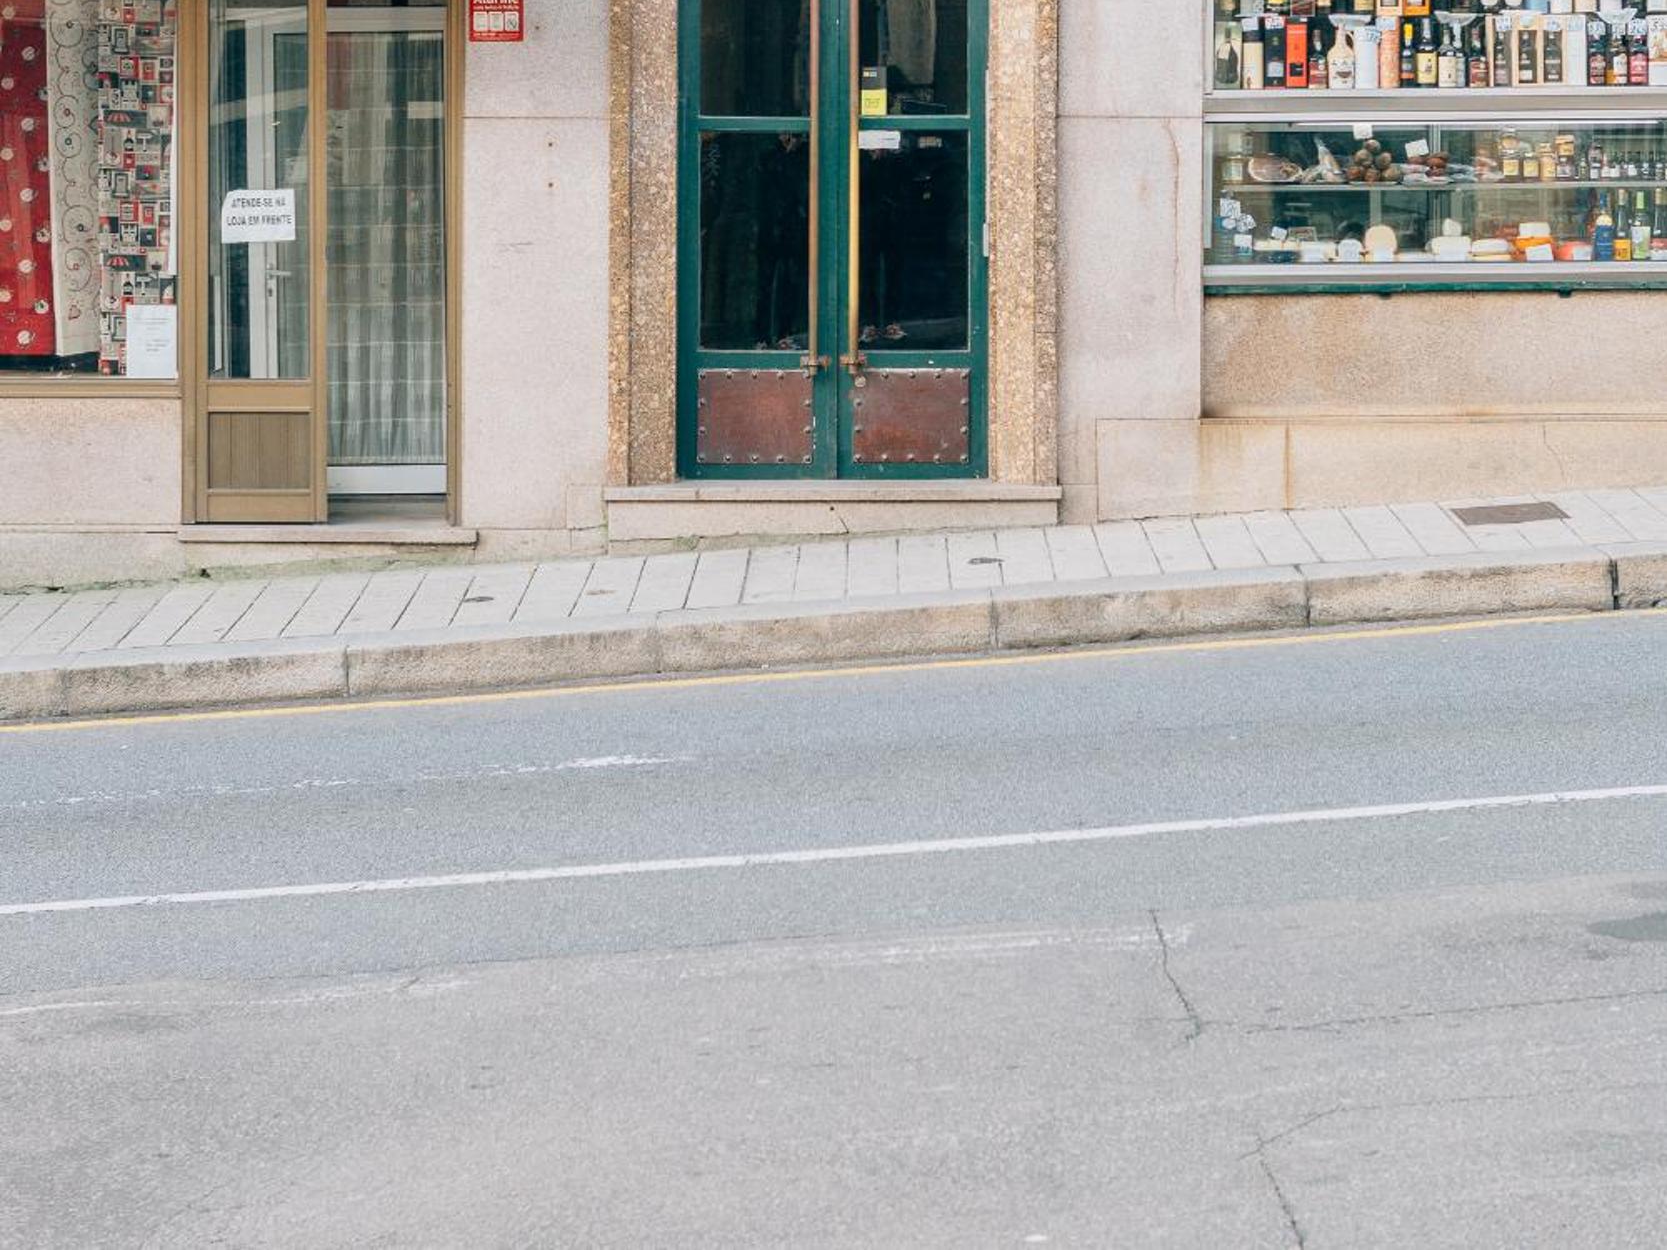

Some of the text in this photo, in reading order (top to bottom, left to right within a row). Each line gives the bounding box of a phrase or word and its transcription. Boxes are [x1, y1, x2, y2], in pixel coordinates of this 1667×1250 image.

[231, 198, 274, 208] ATENDE-SE
[226, 214, 293, 226] LOJA EM FRENTE
